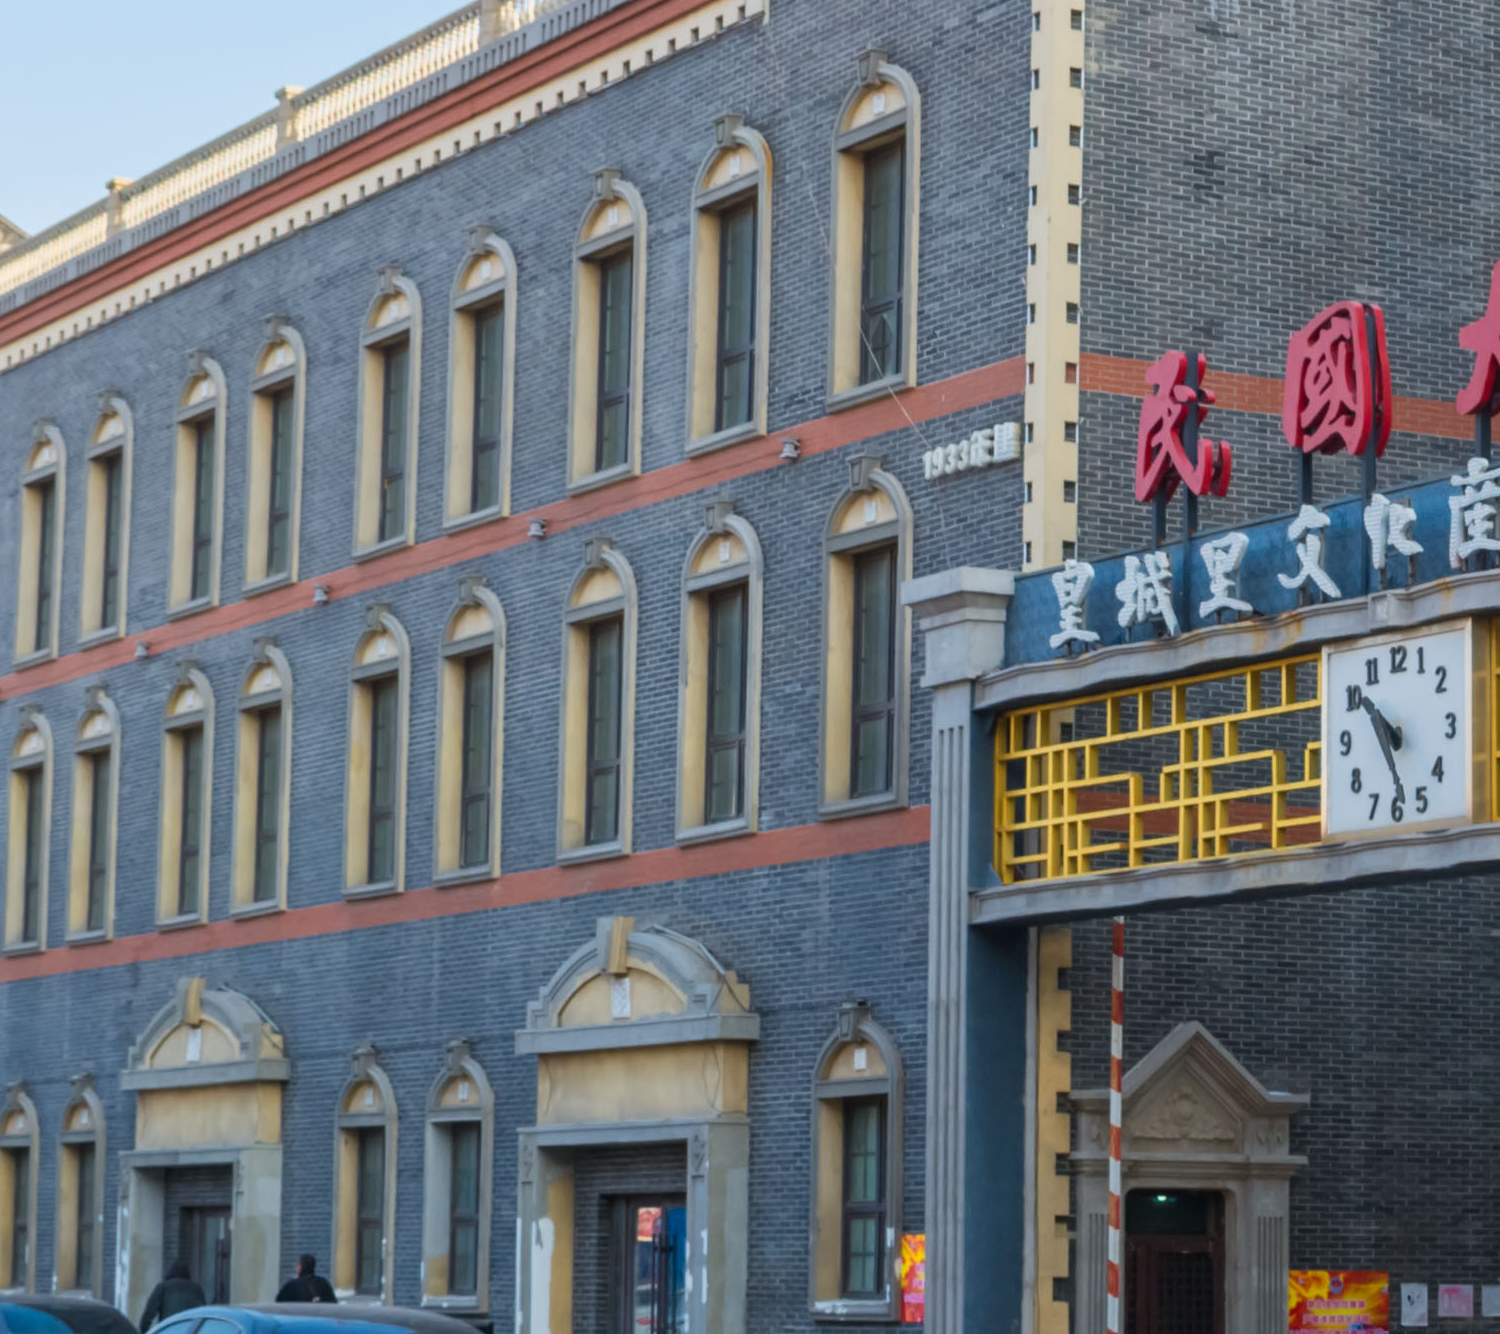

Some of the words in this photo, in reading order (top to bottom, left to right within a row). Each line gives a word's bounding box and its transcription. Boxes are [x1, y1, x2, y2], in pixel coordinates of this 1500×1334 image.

[1365, 657, 1379, 686] 11
[1389, 645, 1407, 674] 12
[1417, 646, 1425, 674] 1
[1435, 665, 1447, 694] 2
[1345, 684, 1362, 712] 10
[1444, 712, 1457, 739] 3
[1340, 730, 1352, 756] 9
[1351, 767, 1362, 794] 8
[1431, 755, 1444, 783] 4
[1368, 793, 1380, 821] 7
[1391, 796, 1404, 822] 6
[1415, 786, 1428, 814] 5
